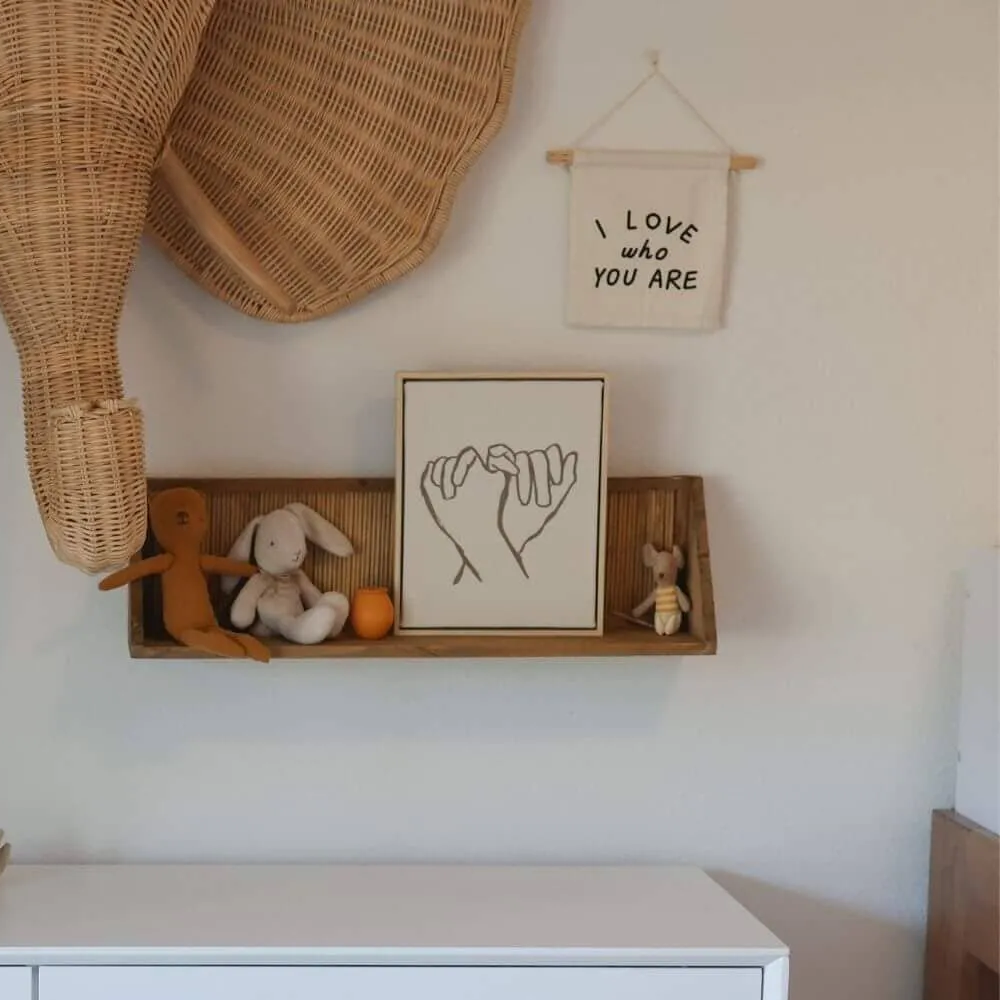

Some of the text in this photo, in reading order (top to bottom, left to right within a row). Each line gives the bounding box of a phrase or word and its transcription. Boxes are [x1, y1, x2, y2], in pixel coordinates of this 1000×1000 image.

[595, 209, 699, 245] I LOVE
[621, 239, 669, 260] who
[594, 267, 698, 290] YOU ARE
